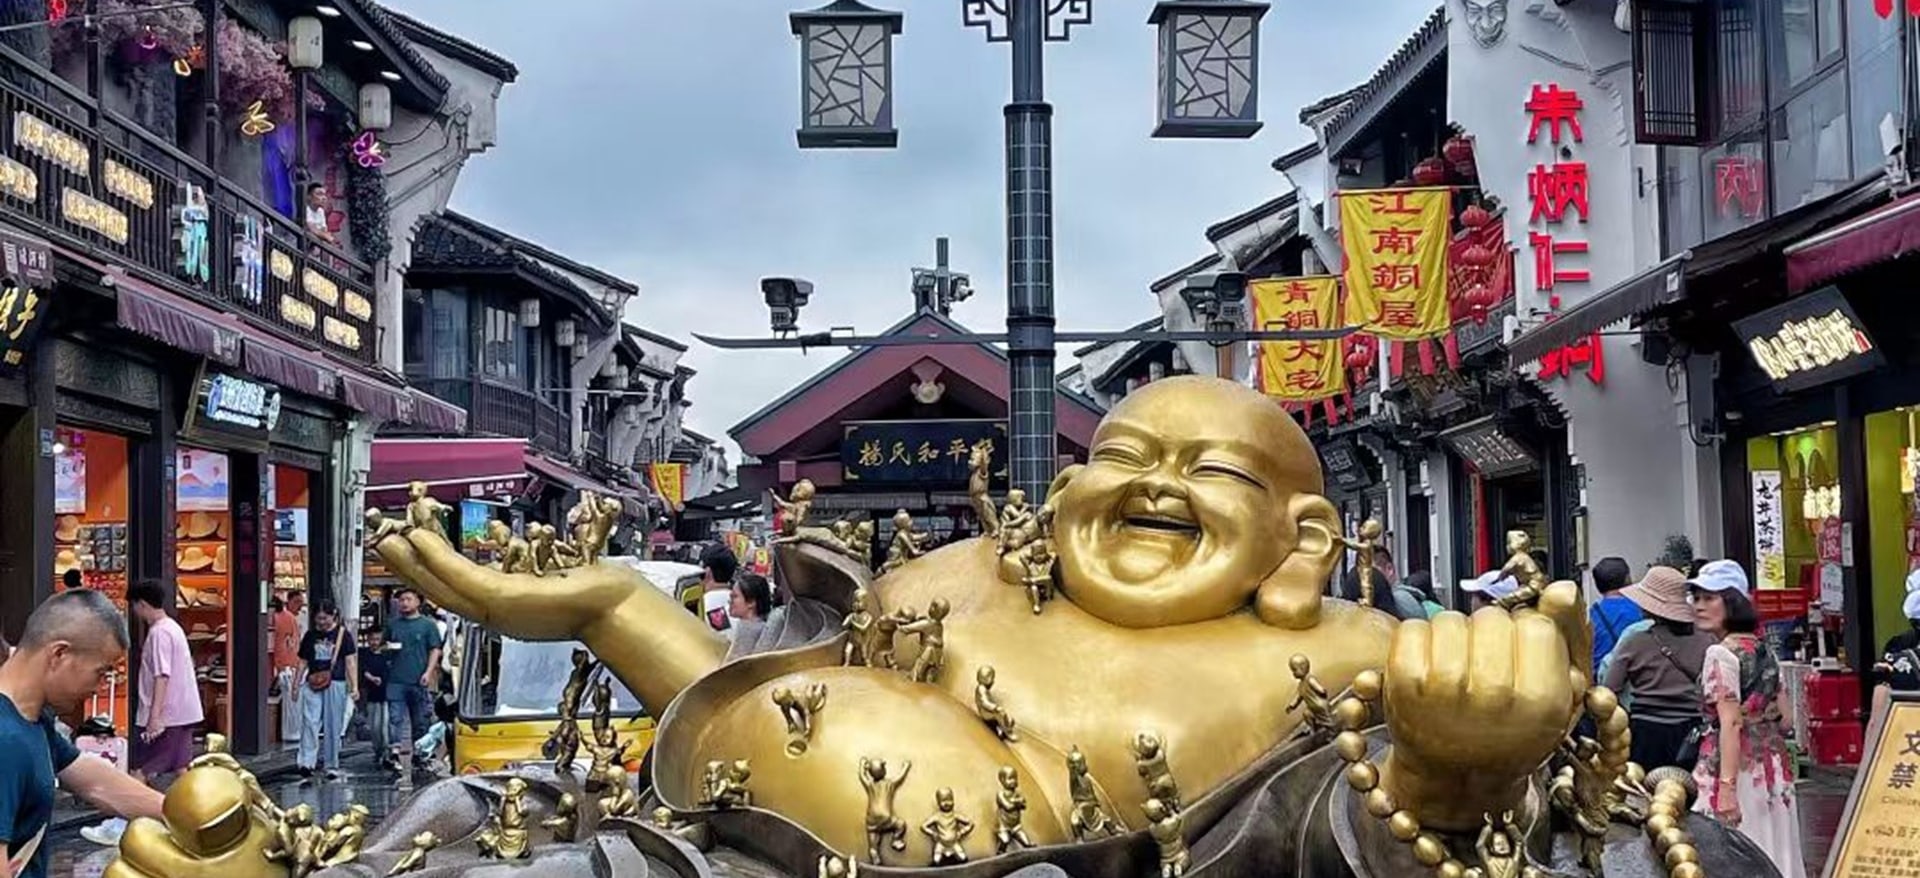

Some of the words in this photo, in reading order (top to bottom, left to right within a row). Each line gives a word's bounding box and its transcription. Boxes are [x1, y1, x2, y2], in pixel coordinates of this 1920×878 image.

[1369, 190, 1423, 328] 江南銅屋
[1276, 281, 1324, 390] 青銅大宅
